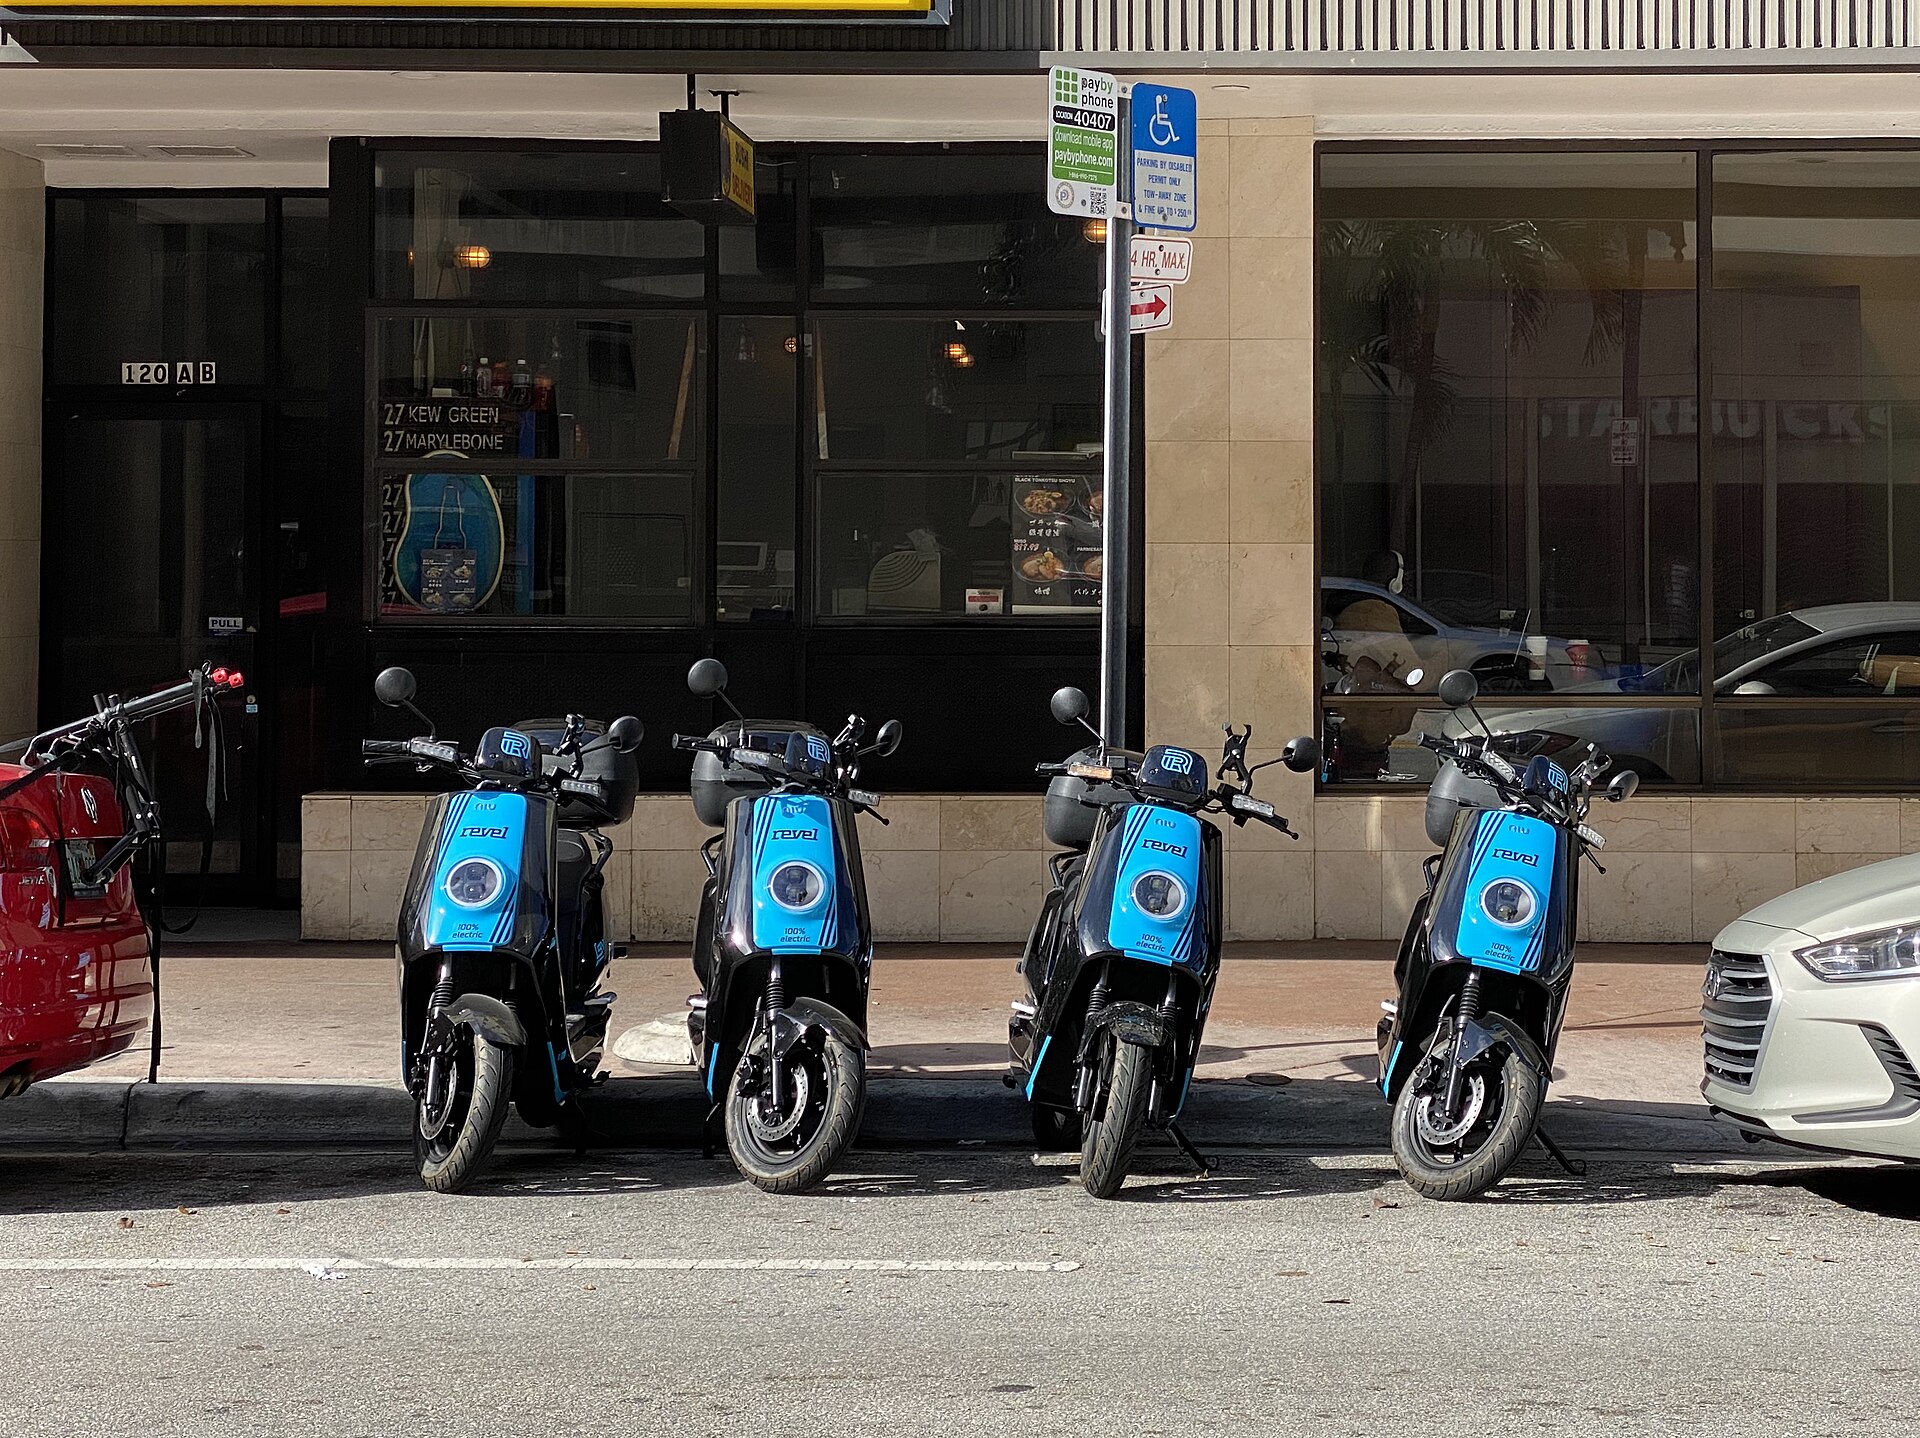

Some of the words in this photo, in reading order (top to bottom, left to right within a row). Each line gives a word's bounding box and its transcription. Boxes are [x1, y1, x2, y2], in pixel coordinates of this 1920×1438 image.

[1081, 93, 1114, 109] phone
[1074, 110, 1112, 130] 40407
[1054, 128, 1082, 145] download
[1082, 133, 1102, 148] mobile
[1101, 138, 1114, 152] app
[1054, 148, 1113, 167] paybyphone.com
[1136, 157, 1158, 168] PARKING
[1159, 160, 1167, 169] BY
[1168, 161, 1193, 173] DISABLED
[1148, 174, 1167, 184] PERMIT
[1168, 176, 1181, 186] ONLY
[1173, 192, 1187, 203] ZONE
[1144, 204, 1156, 214] FINE
[1157, 206, 1165, 215] UP
[1166, 206, 1174, 216] TO
[1141, 250, 1158, 268] HR.
[1161, 251, 1186, 270] MAX.
[125, 364, 167, 383] 120
[383, 403, 406, 425] 27
[408, 405, 442, 423] KEW
[448, 406, 500, 424] GREEN
[383, 430, 405, 452] 27
[405, 433, 504, 450] MARYLEBONE
[382, 484, 404, 508] 27
[382, 511, 403, 534] 27
[211, 619, 240, 628] PULL
[459, 826, 509, 840] revel
[771, 827, 819, 841] revel
[1141, 838, 1188, 860] revel
[1491, 847, 1540, 868] revel
[457, 923, 480, 931] 100%
[784, 927, 806, 935] 100%
[452, 930, 484, 939] electric
[780, 934, 811, 943] electric
[1141, 933, 1163, 944] 100%
[1135, 940, 1166, 953] electric
[1490, 941, 1512, 953] 100%
[1484, 948, 1516, 962] electric
